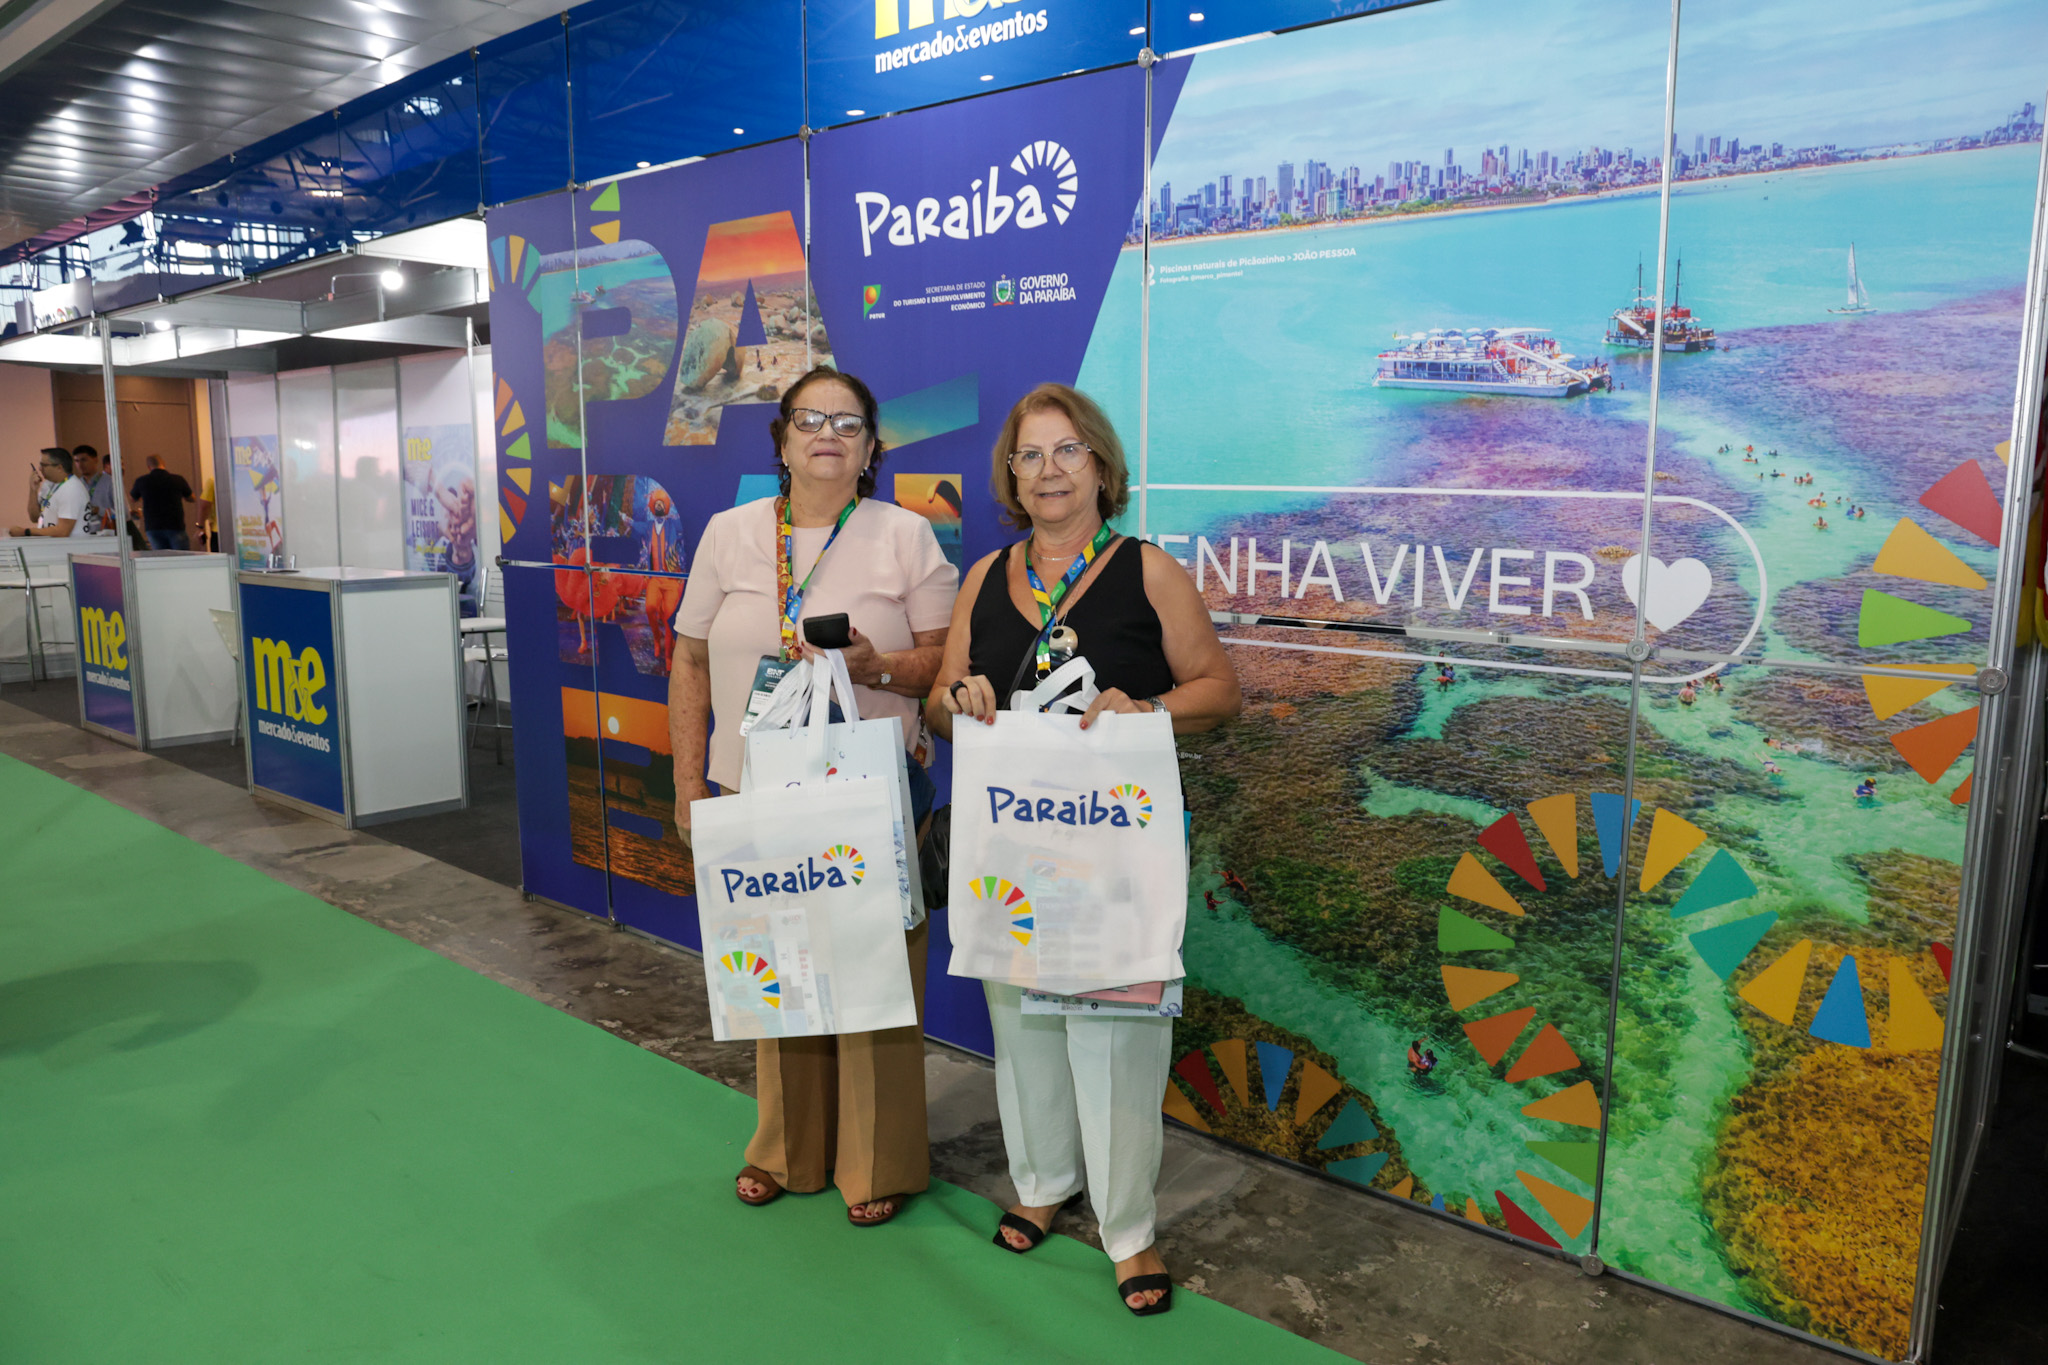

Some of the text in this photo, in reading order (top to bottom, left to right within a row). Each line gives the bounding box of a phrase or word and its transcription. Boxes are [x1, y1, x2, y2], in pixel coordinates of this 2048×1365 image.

[875, 9, 1049, 74] mercado&eventos
[1160, 265, 1191, 274] Piscinas
[1193, 260, 1225, 270] naturais
[1227, 258, 1237, 267] de
[1239, 255, 1285, 266] Picãozinho
[1292, 249, 1318, 261] JOÃO
[1319, 247, 1357, 259] PESSOA
[925, 281, 985, 294] SECRETARIA DE ESTADO
[1019, 273, 1068, 290] GOVERNO
[893, 299, 902, 307] DO
[902, 296, 926, 306] TURISMO
[931, 291, 985, 303] DESENVOLVIMENTO
[1019, 286, 1076, 304] DA PARAÍBA
[951, 301, 985, 311] ECONÔMICO
[410, 498, 435, 517] MICE &
[411, 519, 440, 540] LEISURE
[1360, 541, 1595, 621] VIVER
[81, 606, 128, 671] m&e
[86, 670, 131, 691] mercado&eventos
[252, 636, 328, 725] m&e
[258, 718, 330, 753] mercado&eventos
